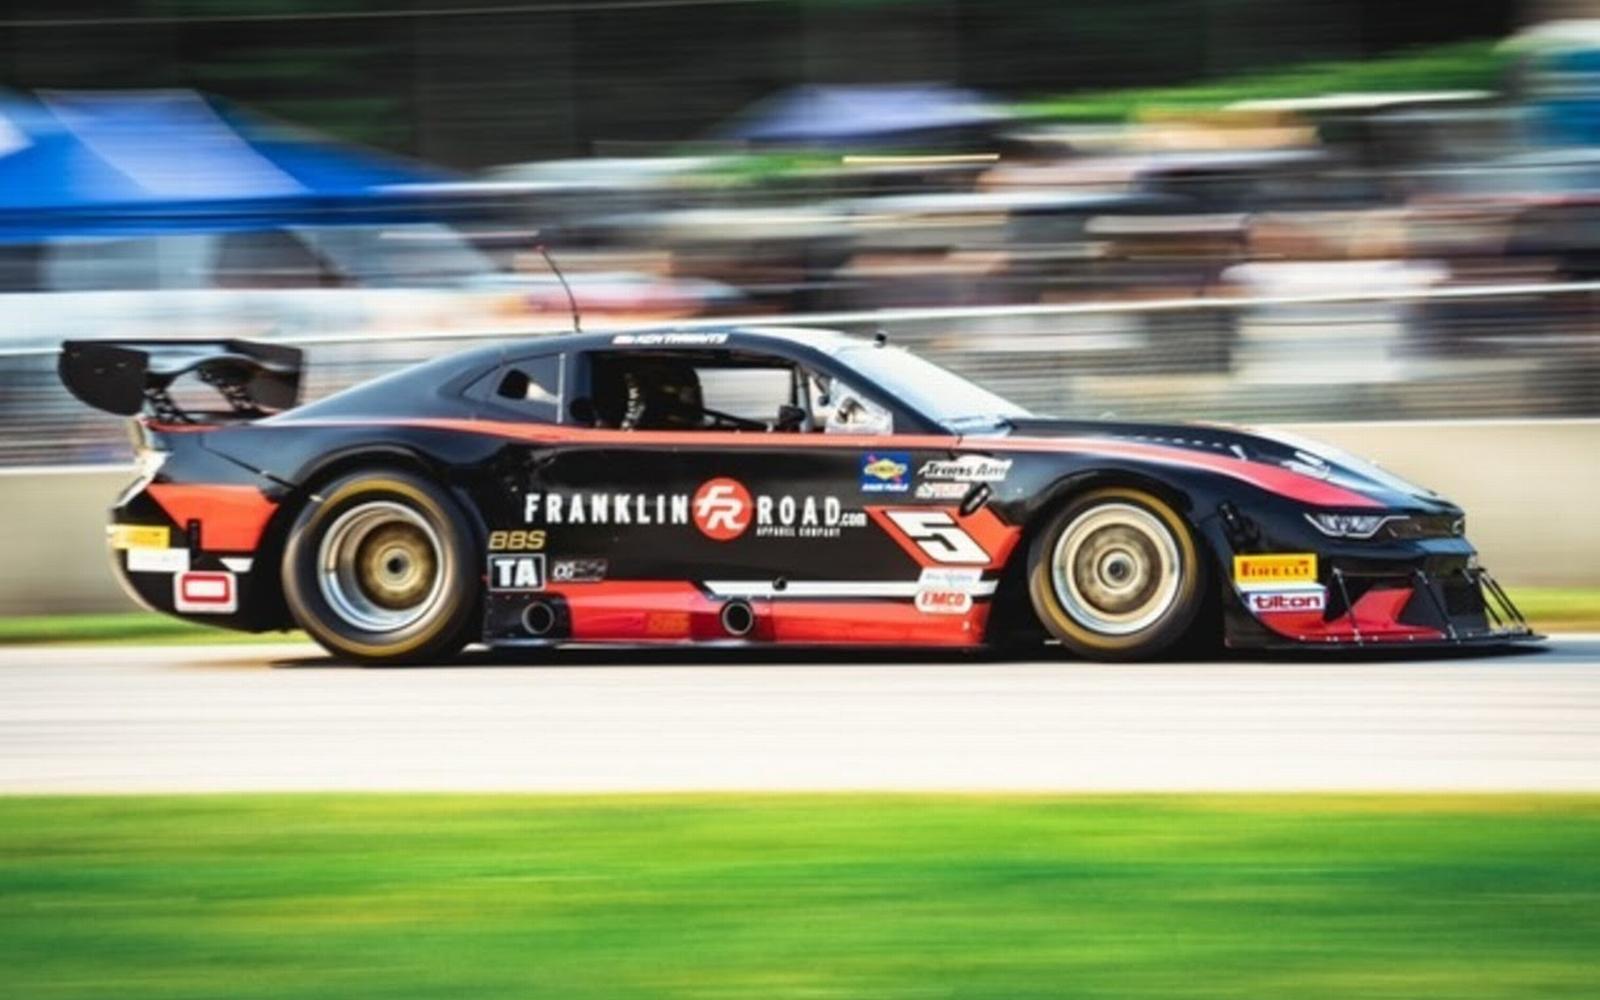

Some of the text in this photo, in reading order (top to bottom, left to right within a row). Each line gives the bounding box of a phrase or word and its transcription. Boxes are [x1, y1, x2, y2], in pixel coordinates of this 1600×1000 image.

[524, 492, 689, 525] FRANKLIN
[756, 494, 868, 527] ROAD.com
[488, 530, 546, 551] BBS
[756, 527, 841, 538] APPAREL COMPANY
[885, 510, 992, 564] 5
[494, 558, 539, 588] TA
[1240, 559, 1309, 577] PIRELLI
[1254, 595, 1321, 610] tilton
